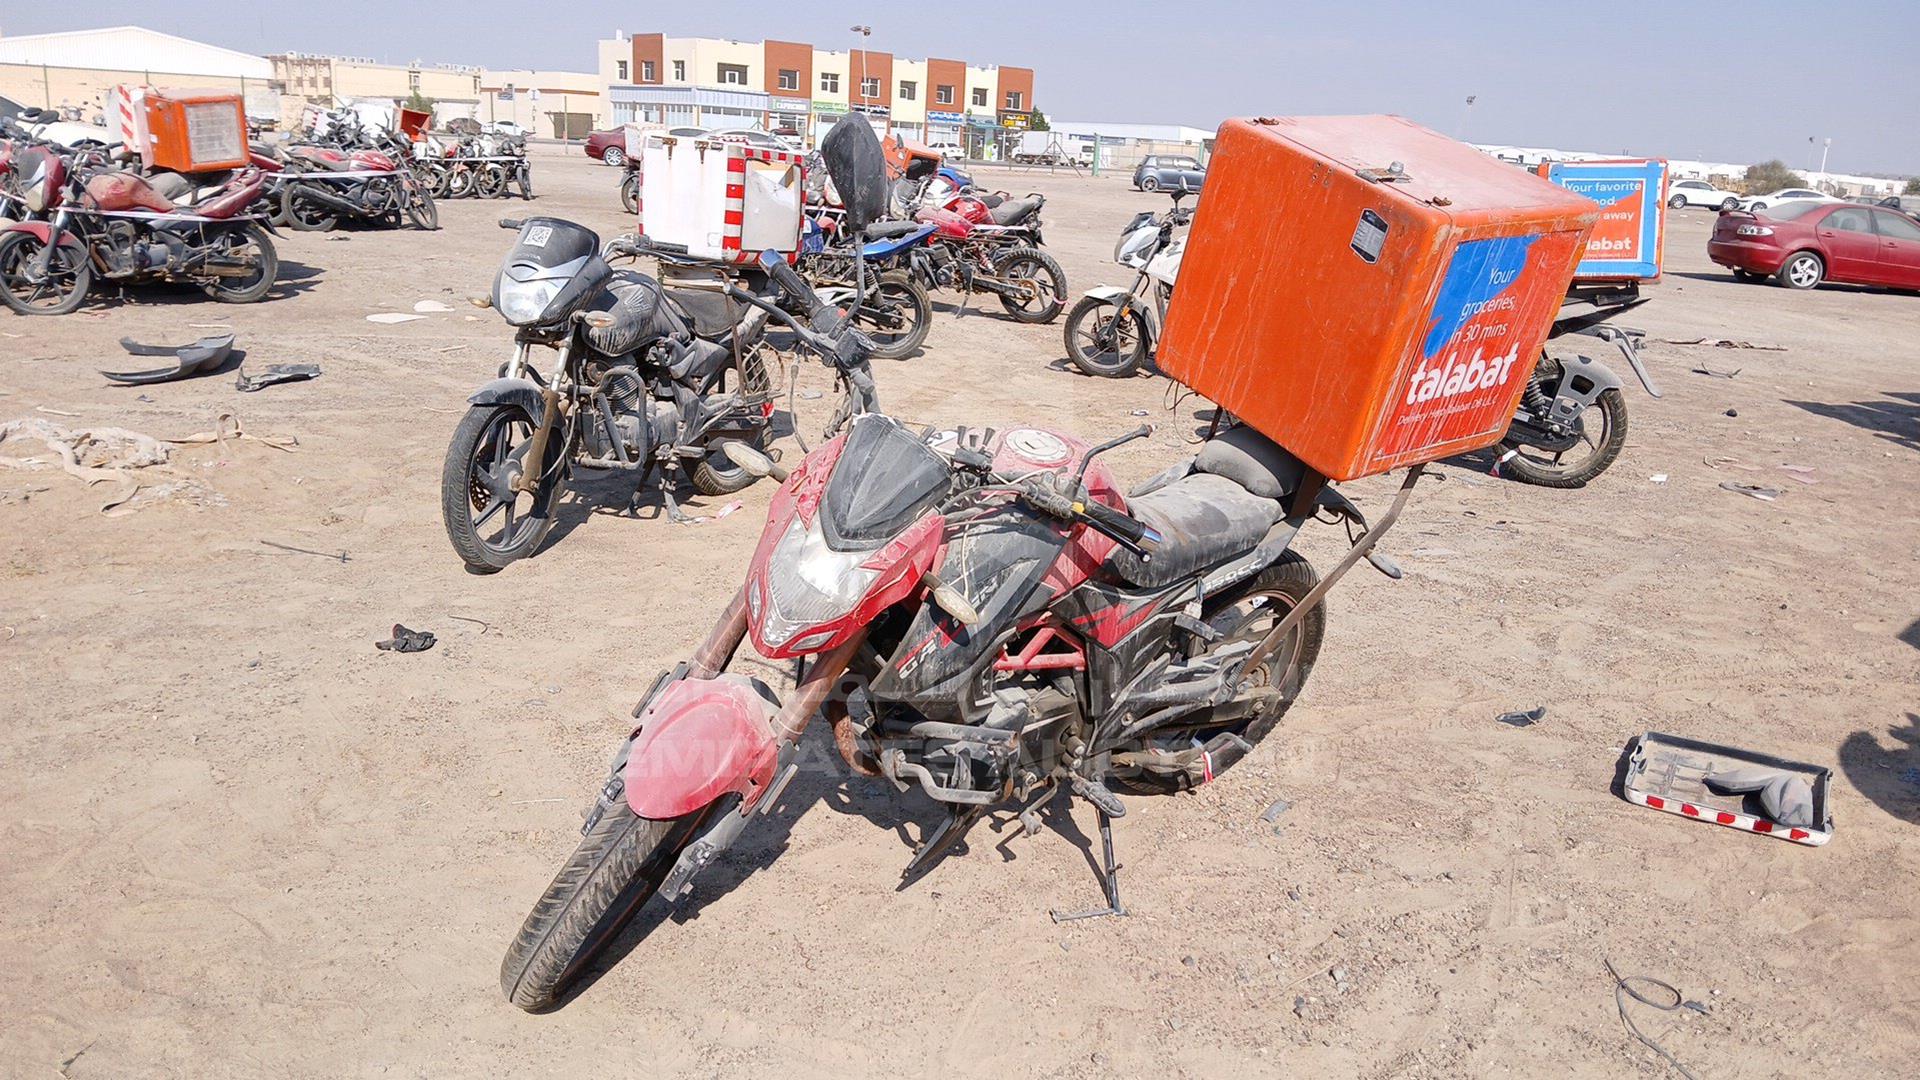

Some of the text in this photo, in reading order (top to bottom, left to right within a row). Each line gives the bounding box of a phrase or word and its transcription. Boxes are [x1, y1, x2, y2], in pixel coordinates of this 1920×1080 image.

[1566, 181, 1642, 193] Your favorite
[1603, 212, 1635, 222] away
[1488, 268, 1516, 285] Your
[1459, 293, 1516, 321] groceries,
[1463, 324, 1481, 342] 30
[1480, 320, 1509, 340] mins
[1406, 341, 1520, 406] talabat
